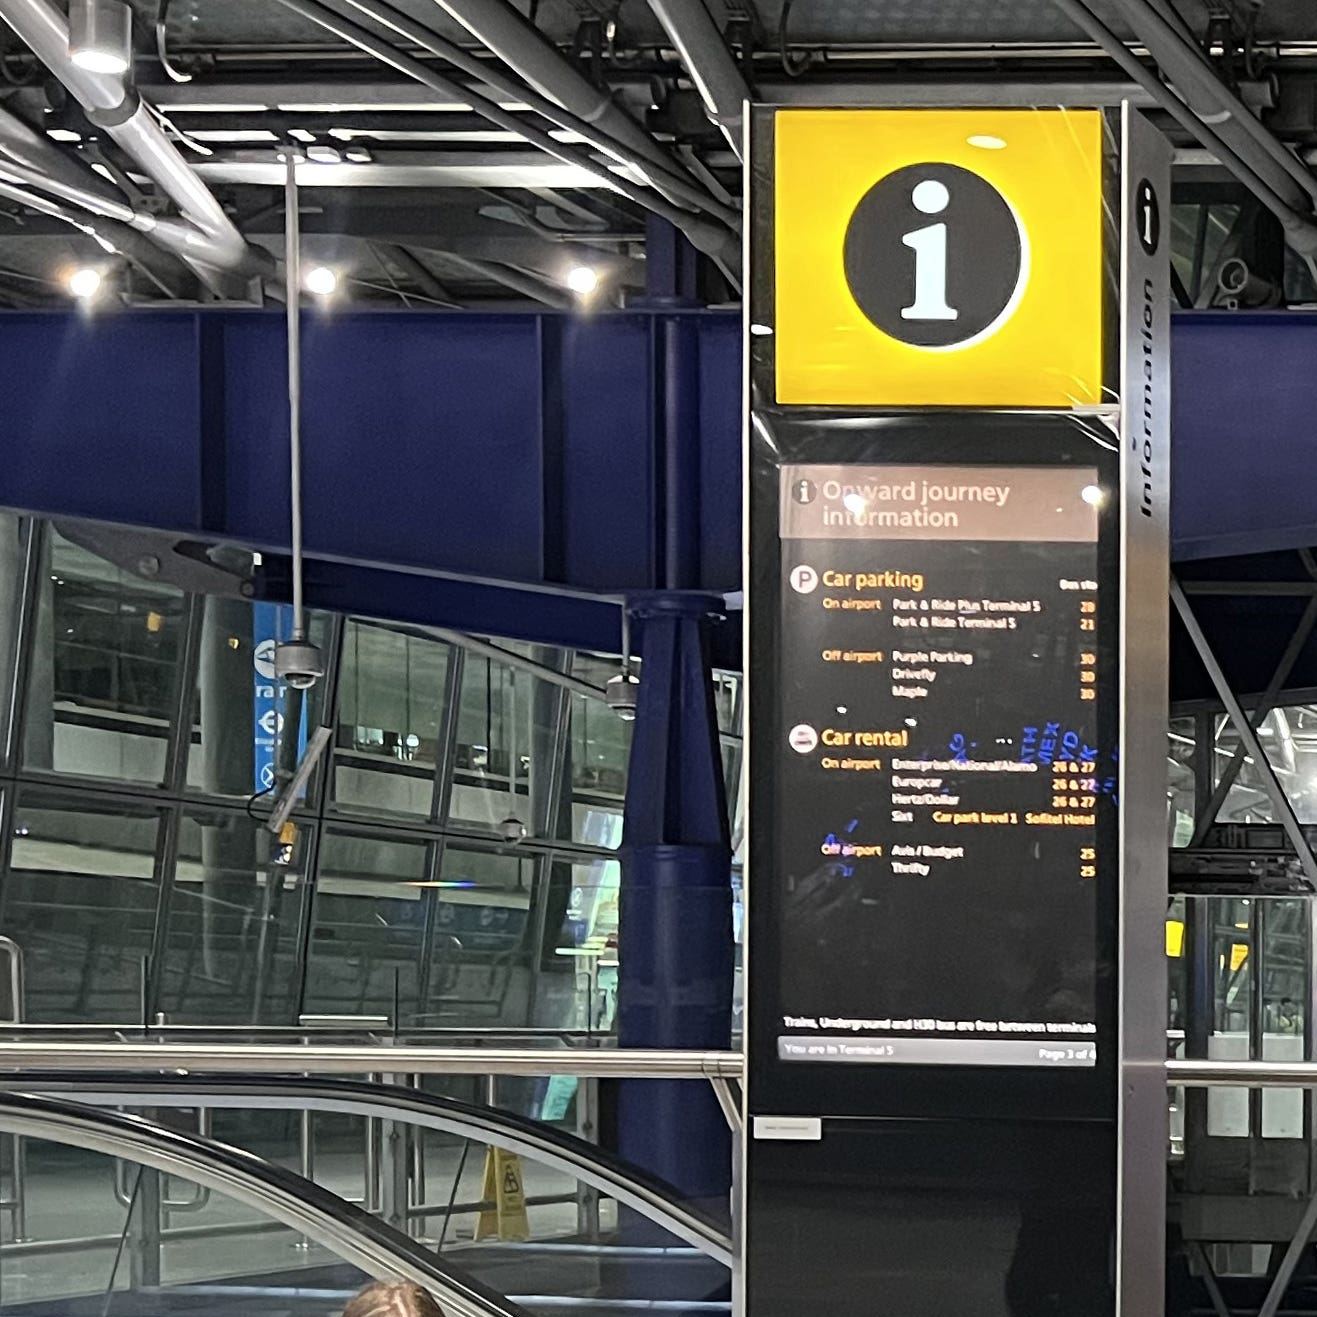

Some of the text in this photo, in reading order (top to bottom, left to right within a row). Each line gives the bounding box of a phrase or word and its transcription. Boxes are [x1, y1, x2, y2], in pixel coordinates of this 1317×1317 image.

[823, 481, 1011, 506] Onward journey
[823, 506, 959, 527] information
[822, 571, 924, 591] Car parking
[822, 598, 882, 611] On airport
[893, 599, 918, 610] Park
[931, 599, 957, 611] Ride
[982, 600, 1032, 612] Terminal
[1032, 601, 1041, 612] 5
[893, 616, 918, 627] Park
[931, 616, 957, 628] Ride
[957, 617, 1007, 629] Terminal
[1008, 618, 1017, 629] 5
[822, 650, 883, 663] Off airport
[893, 651, 973, 665] Purple Parking
[821, 729, 909, 746] Car rental
[821, 758, 881, 770] On airport
[932, 811, 952, 823] Car
[953, 812, 980, 825] park
[1064, 814, 1096, 825] Hotel
[842, 844, 882, 856] airport
[819, 1017, 892, 1031] Underground
[892, 1018, 913, 1030] and
[784, 1044, 806, 1054] You
[807, 1045, 825, 1054] are
[826, 1045, 838, 1054] in
[838, 1044, 885, 1055] Terminal
[1039, 1048, 1066, 1061] Page
[1075, 1050, 1088, 1060] of
